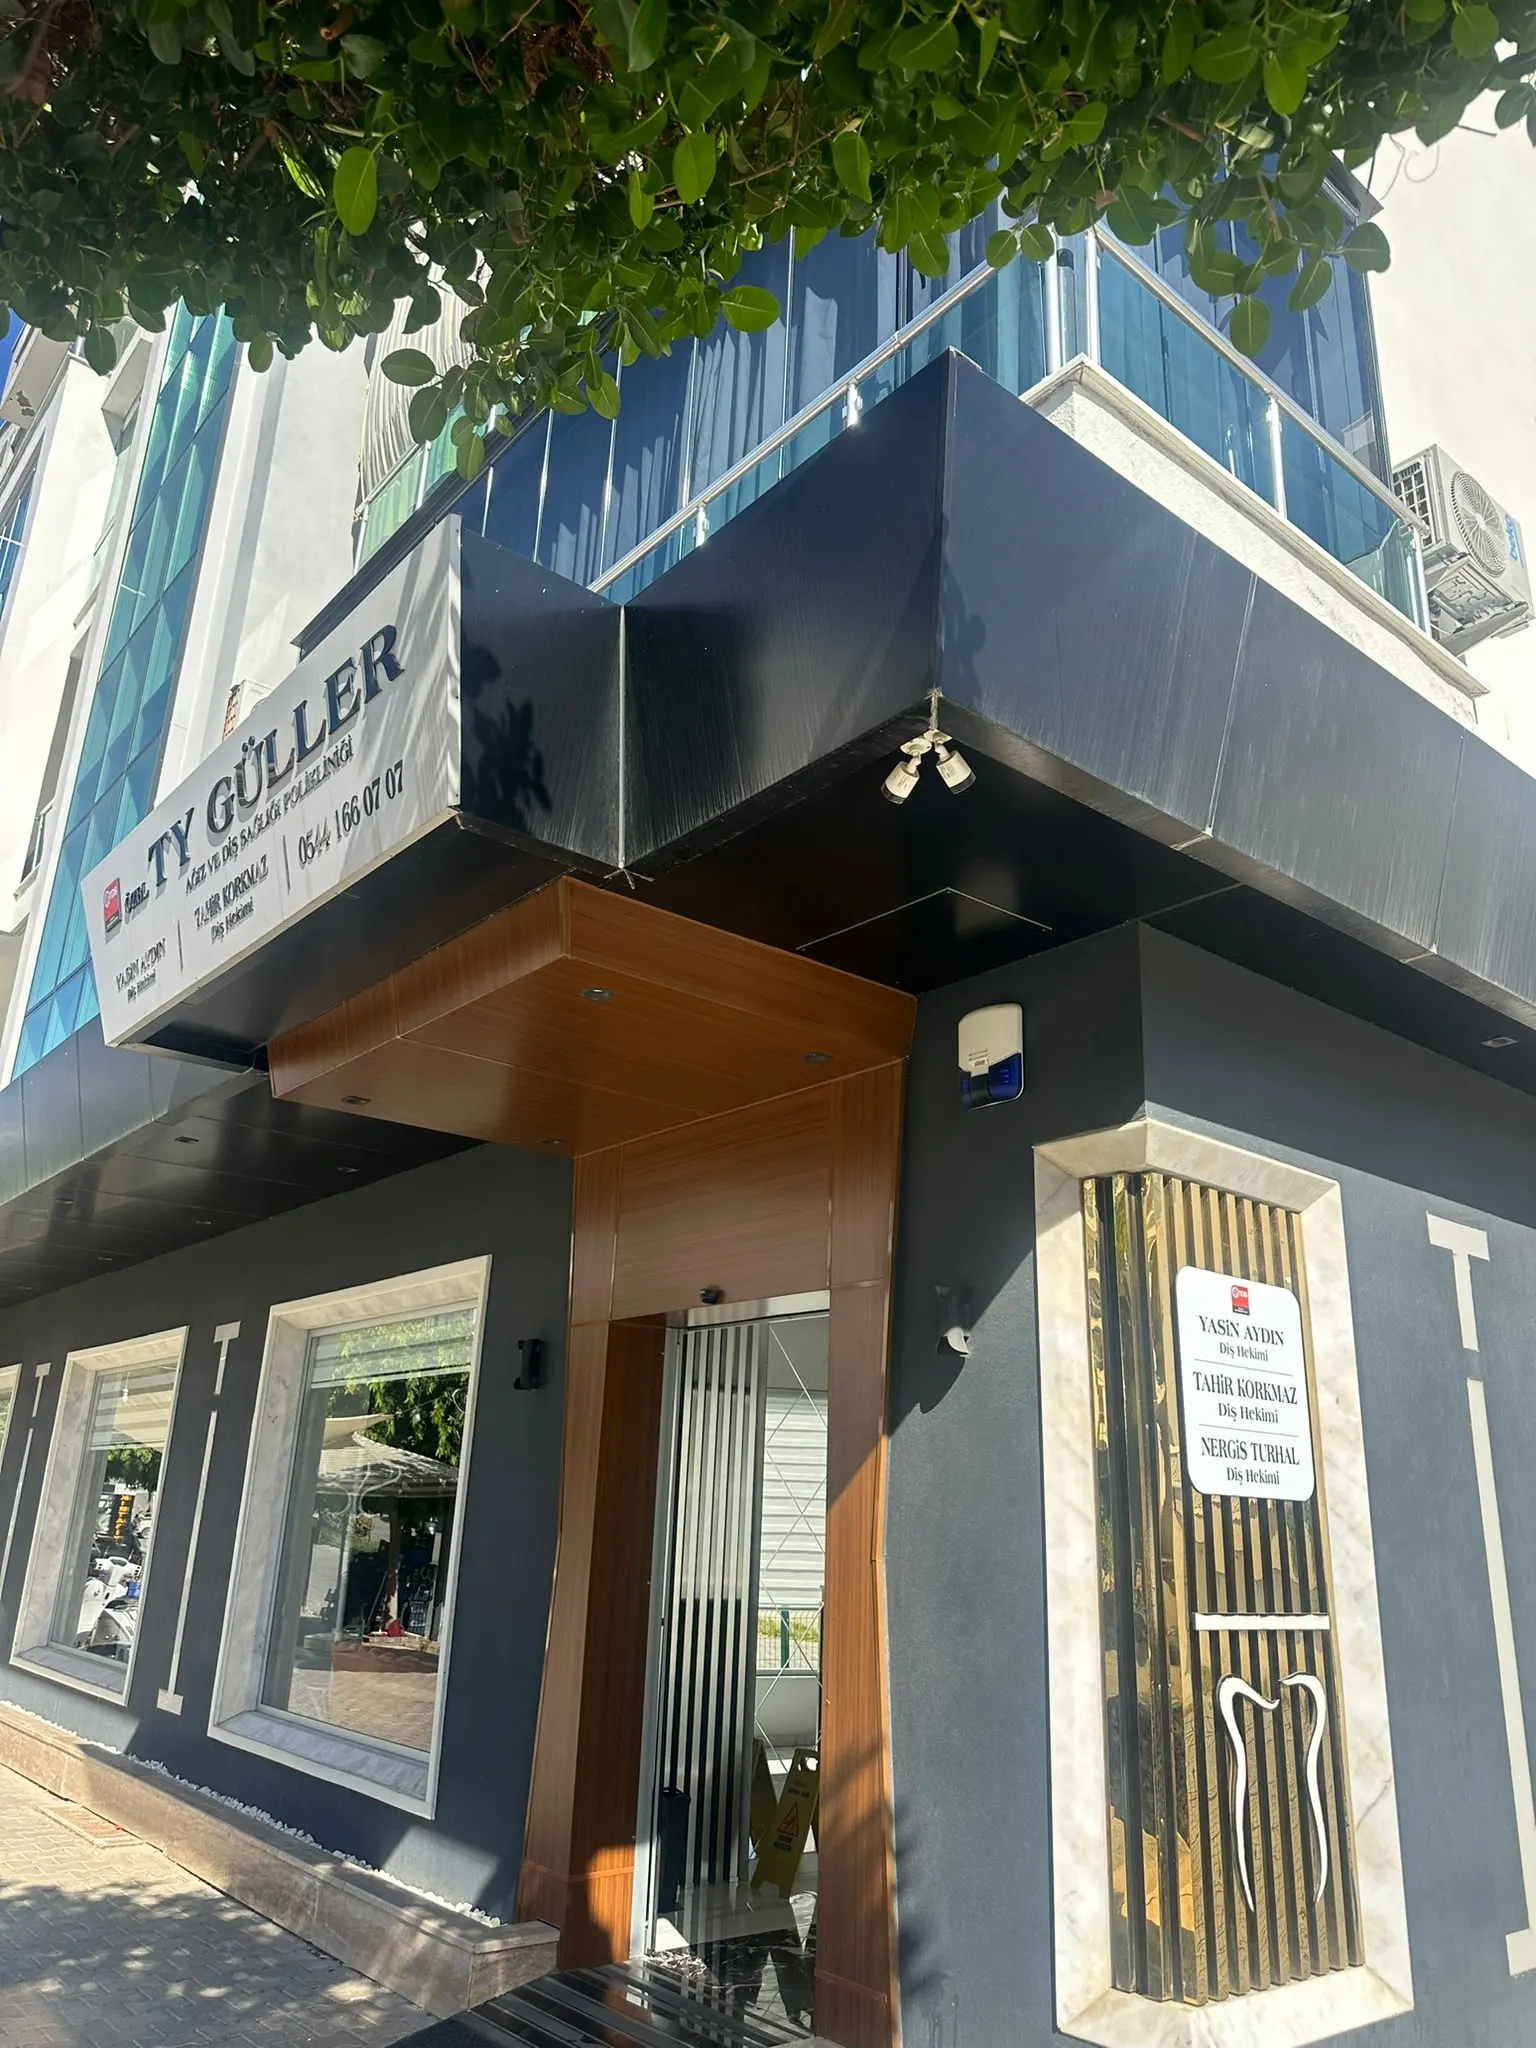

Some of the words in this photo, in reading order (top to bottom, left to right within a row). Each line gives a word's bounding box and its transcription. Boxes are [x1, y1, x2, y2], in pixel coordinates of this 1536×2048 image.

[148, 807, 195, 887] TY
[207, 624, 405, 835] GÜLLER
[335, 795, 360, 839] 166
[363, 777, 381, 817] 07
[385, 759, 404, 800] 07
[207, 852, 221, 874] VE
[1244, 1325, 1285, 1347] AYDIN
[1219, 1342, 1236, 1360] Diş
[1236, 1344, 1269, 1362] Hekimi
[1238, 1378, 1298, 1405] KORKMAZ
[1218, 1403, 1237, 1422] Diş
[1240, 1405, 1280, 1424] Hekimi
[1250, 1442, 1300, 1466] TURHAL
[1226, 1467, 1244, 1486] Diş
[1246, 1468, 1281, 1486] Hekimi
